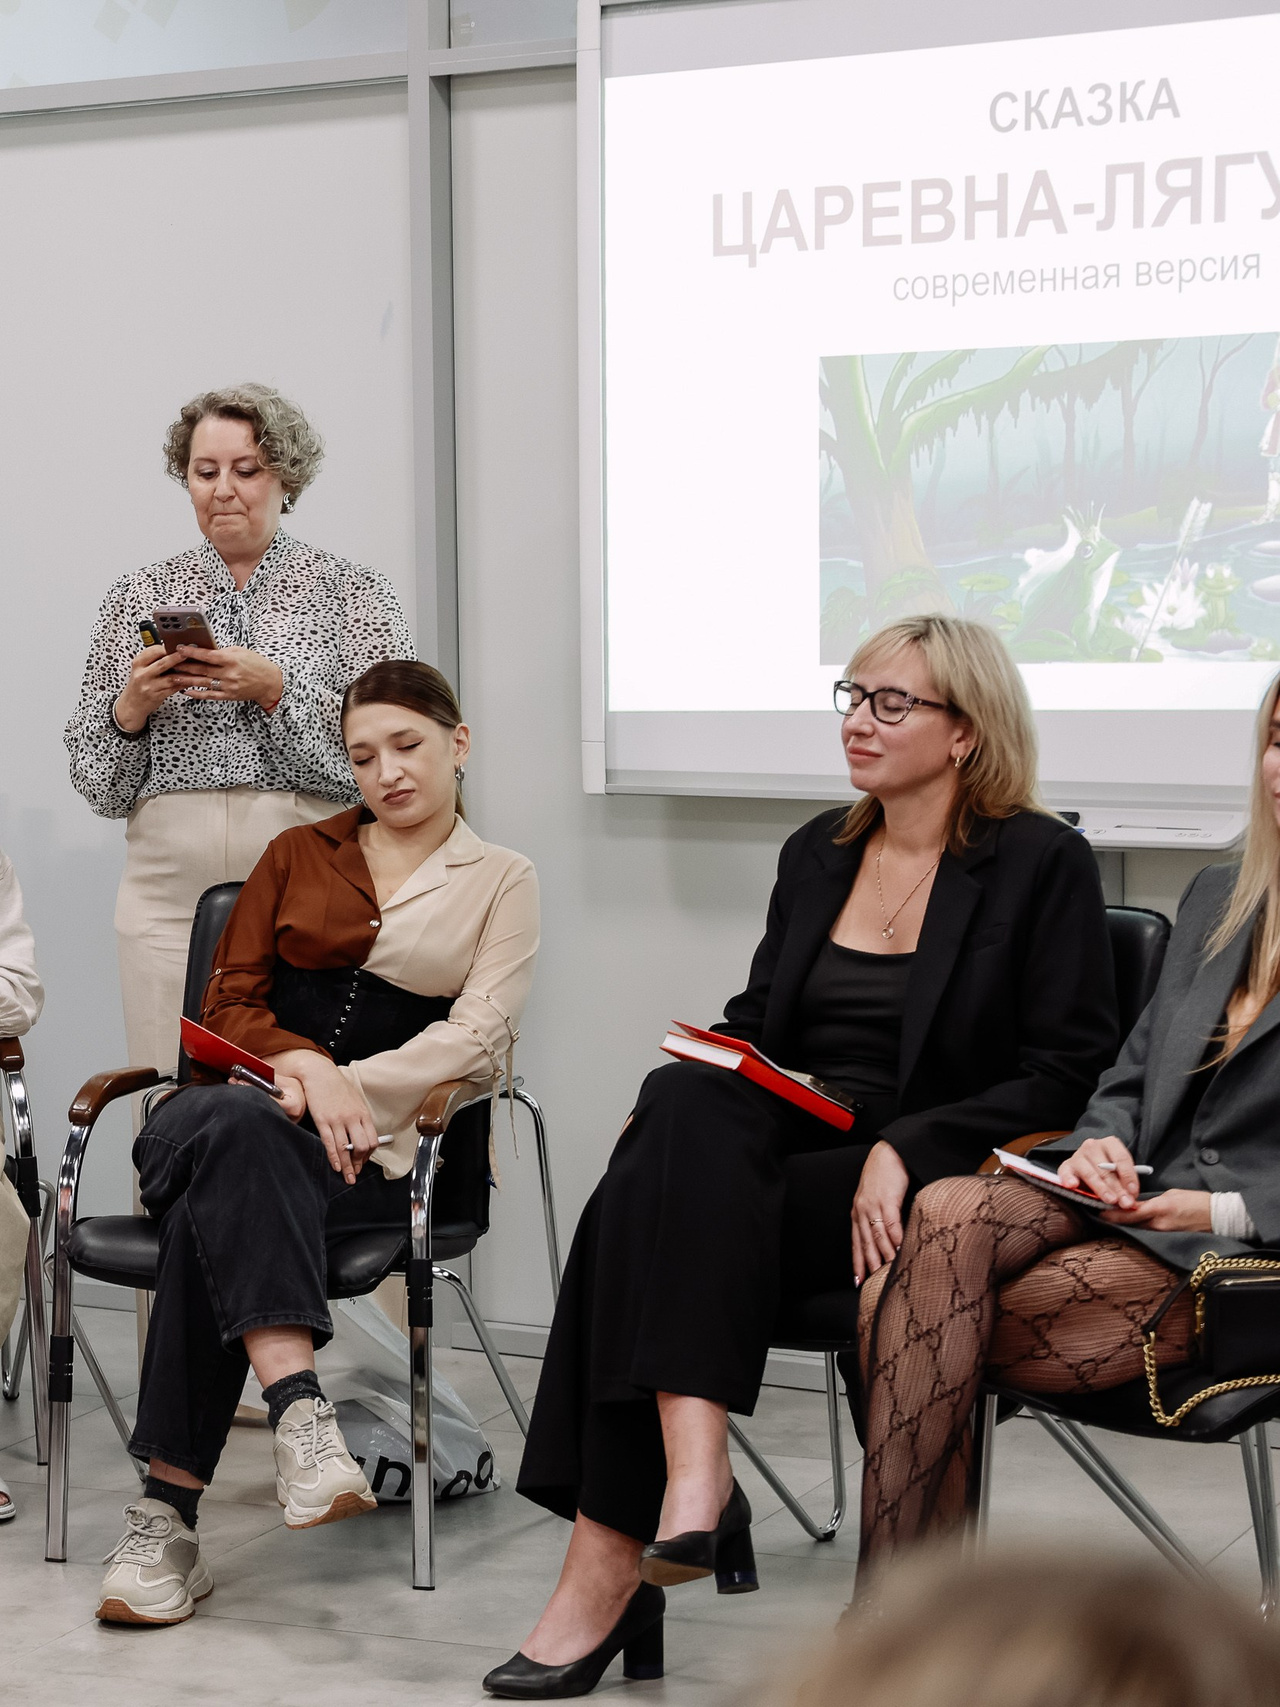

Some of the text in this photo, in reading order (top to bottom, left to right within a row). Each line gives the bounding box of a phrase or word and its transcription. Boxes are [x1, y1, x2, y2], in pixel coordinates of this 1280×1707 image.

[989, 77, 1181, 134] СКАЗКА
[893, 253, 1261, 308] современная версия
